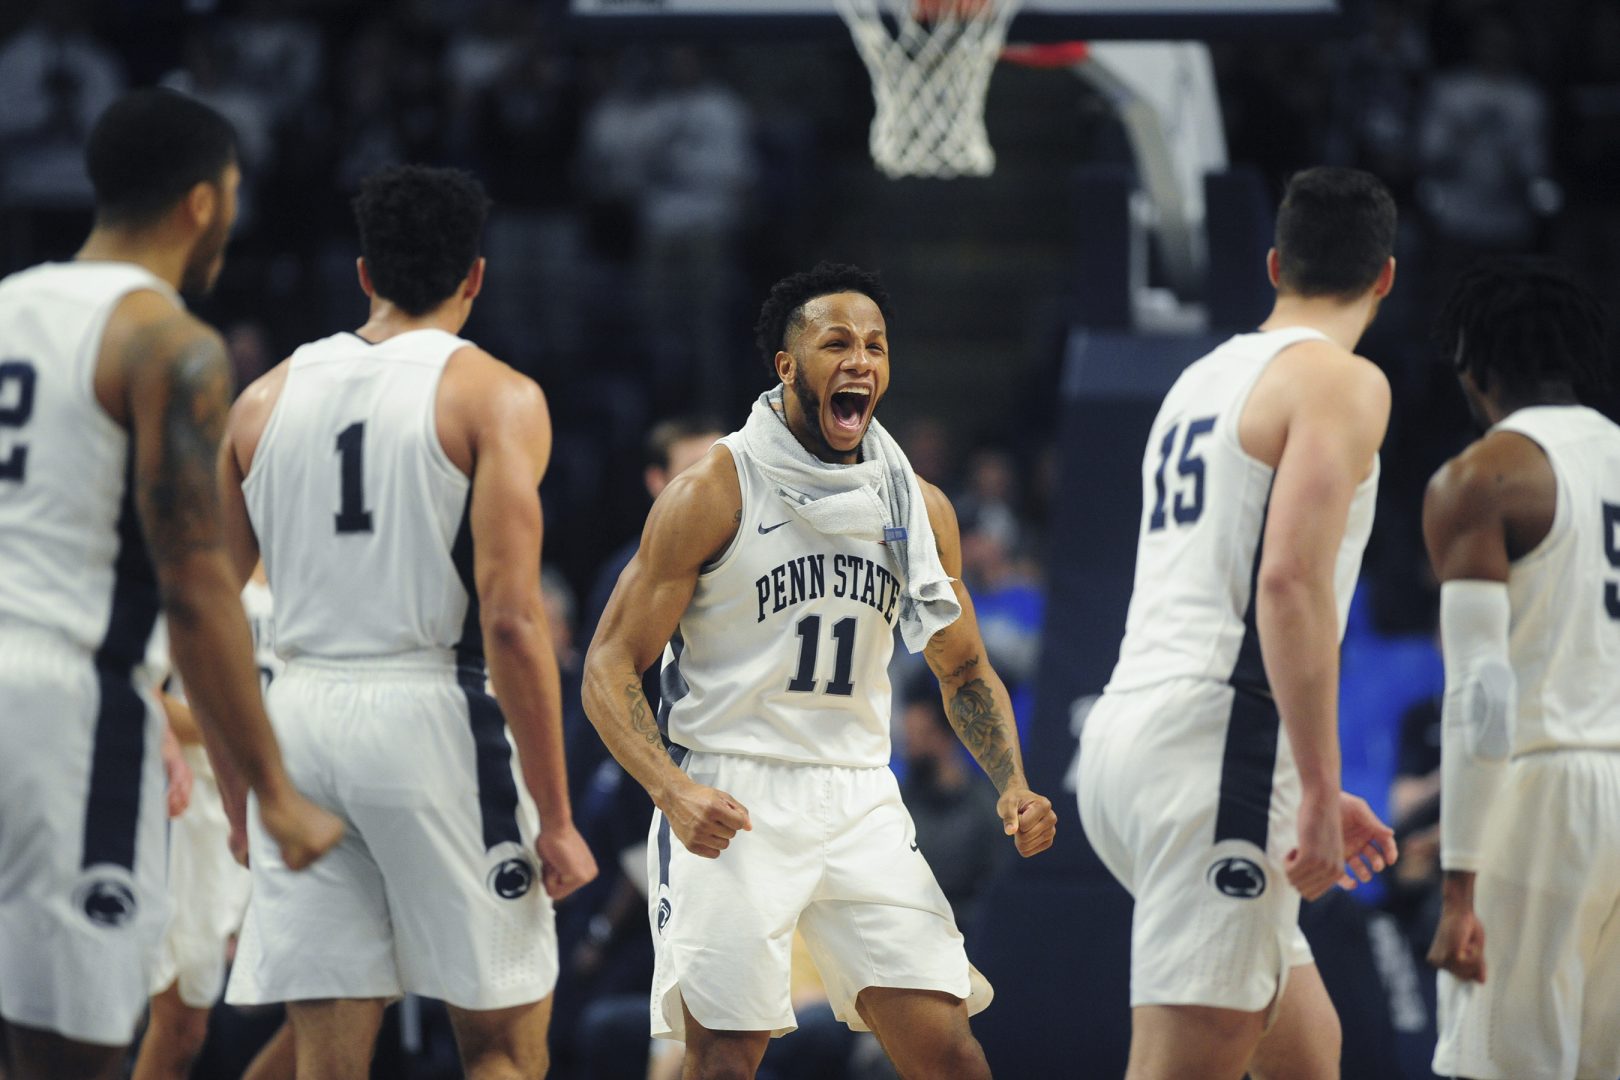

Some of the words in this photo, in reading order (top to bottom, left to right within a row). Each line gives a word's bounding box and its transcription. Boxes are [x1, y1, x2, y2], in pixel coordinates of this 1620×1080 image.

[334, 419, 375, 535] 1
[1148, 414, 1218, 533] 15
[756, 554, 825, 623] PENN
[833, 554, 901, 625] STATE
[786, 613, 858, 696] 11
